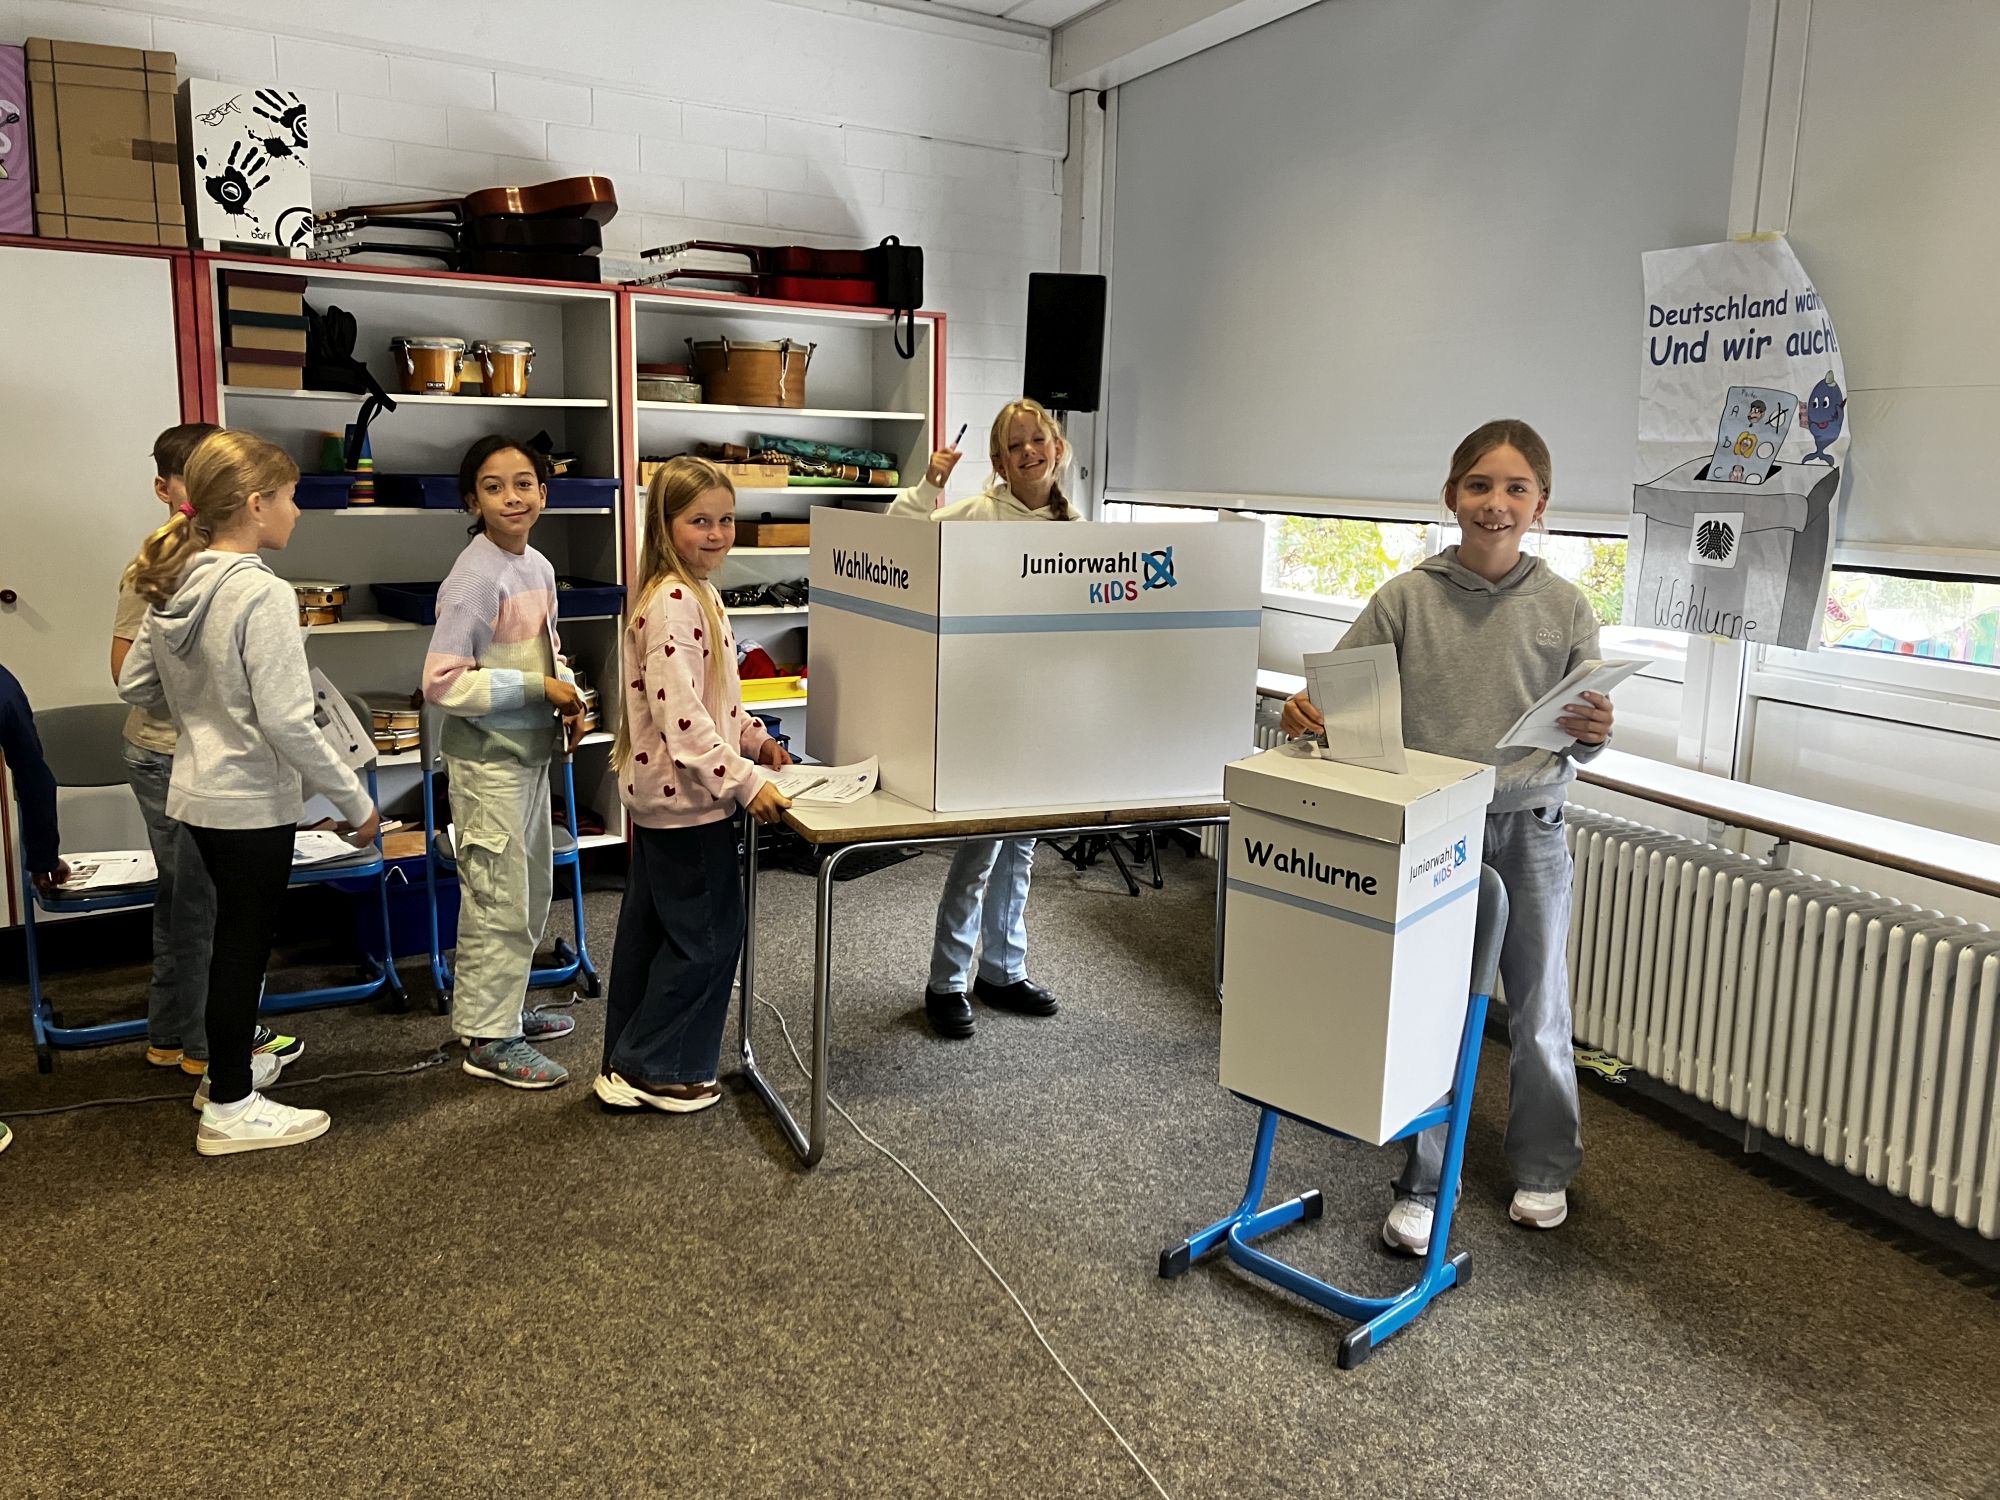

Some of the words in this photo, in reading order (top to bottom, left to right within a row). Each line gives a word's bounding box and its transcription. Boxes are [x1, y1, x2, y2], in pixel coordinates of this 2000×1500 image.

[1649, 289, 1788, 328] Deutschland
[1650, 330, 1709, 366] Und
[1723, 328, 1772, 362] wir
[1786, 317, 1838, 357] auch!
[1730, 404, 1740, 418] A
[1713, 466, 1723, 479] C
[832, 548, 910, 590] Wahlkabine
[1020, 550, 1138, 579] Juniorwahl
[1089, 580, 1138, 604] KIDS
[1654, 576, 1757, 642] Wahlurne
[1244, 837, 1378, 896] Wahlurne
[1408, 844, 1453, 884] Juniorwahl
[1433, 863, 1453, 888] KIDS
